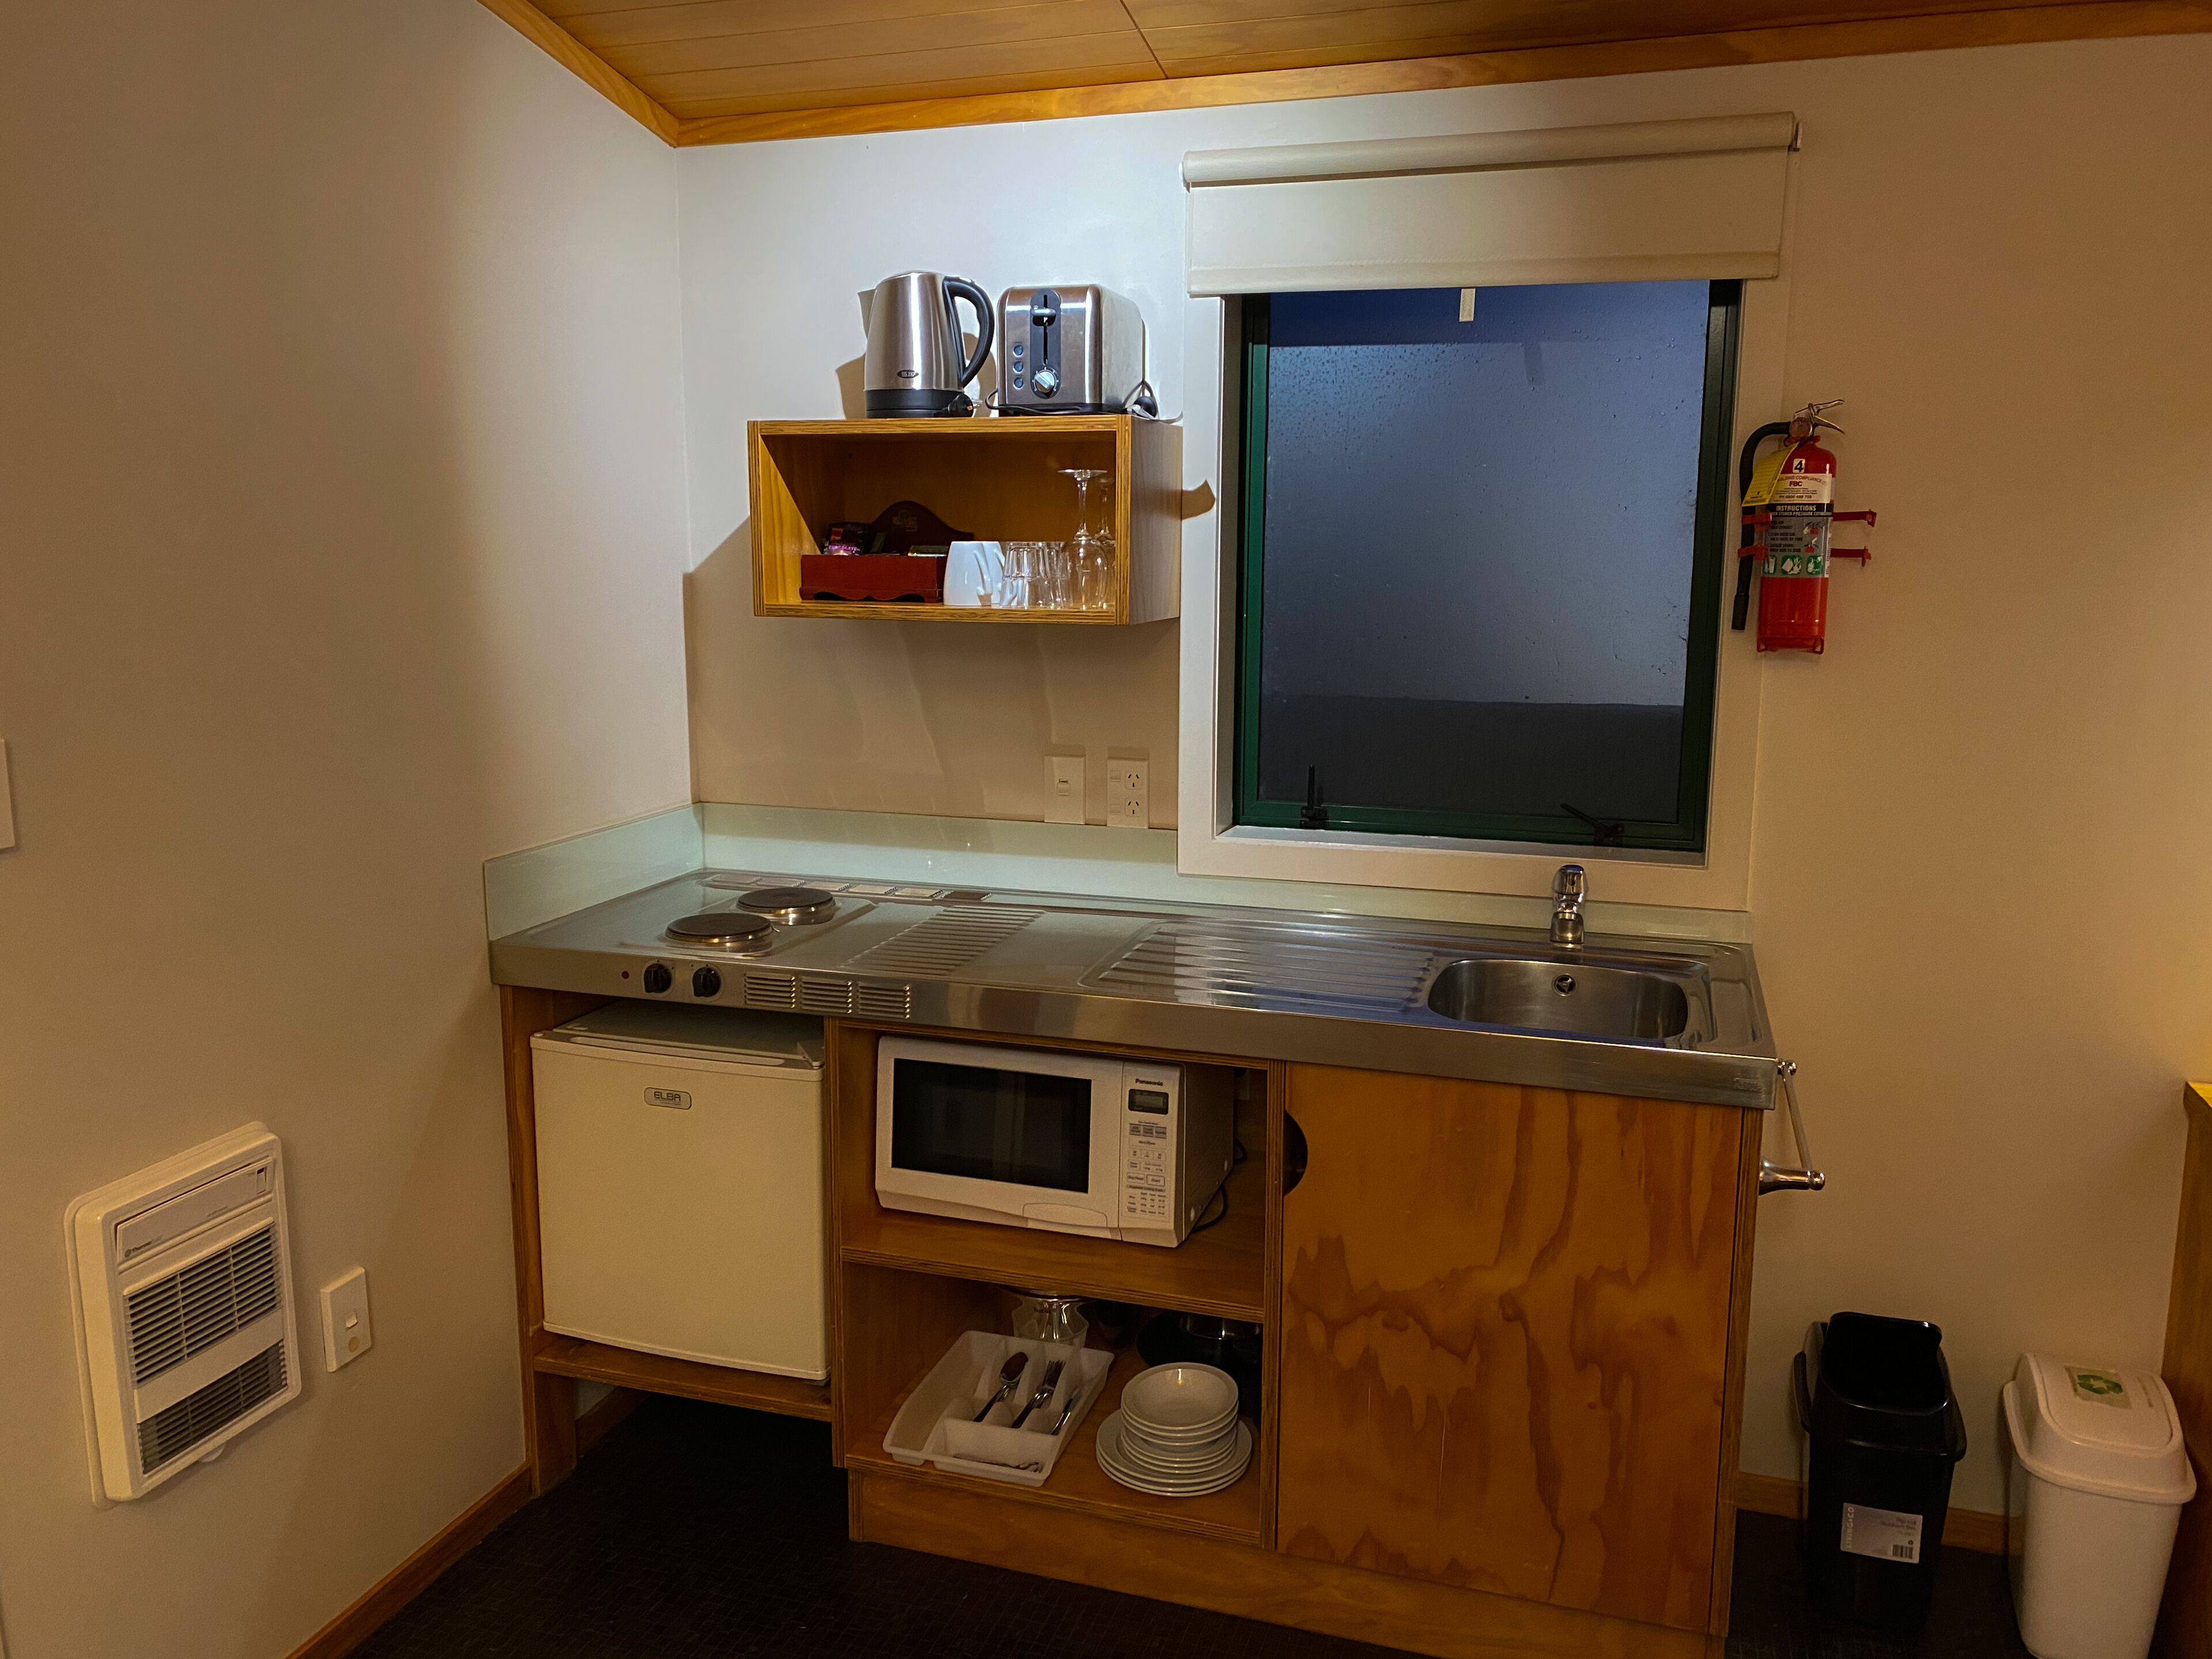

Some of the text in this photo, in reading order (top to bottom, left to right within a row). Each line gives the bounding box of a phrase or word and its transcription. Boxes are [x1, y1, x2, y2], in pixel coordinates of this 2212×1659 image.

[1794, 460, 1804, 472] 4
[1135, 1078, 1163, 1086] Panasonic
[654, 1091, 681, 1101] ELBA
